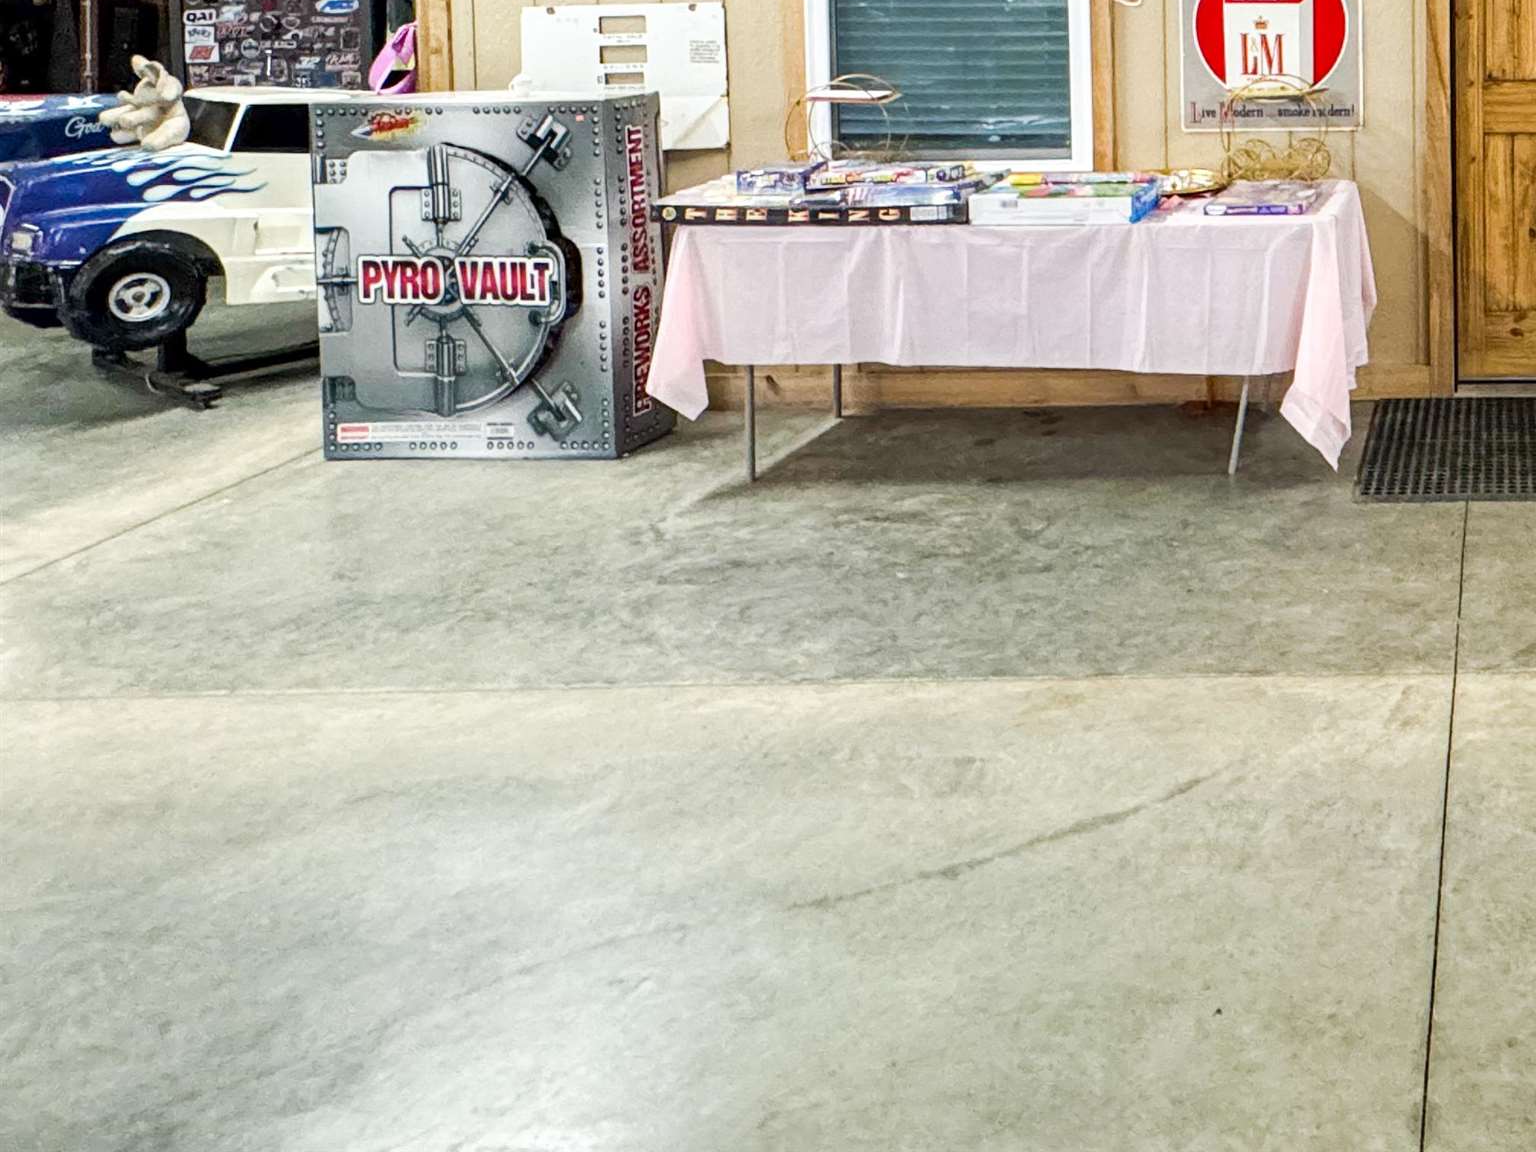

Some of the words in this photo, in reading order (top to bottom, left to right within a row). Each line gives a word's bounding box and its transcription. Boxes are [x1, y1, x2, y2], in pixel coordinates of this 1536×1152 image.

[1190, 101, 1217, 124] Live
[1277, 102, 1311, 118] smoke
[625, 124, 651, 275] ASSORTMENT
[360, 258, 443, 302] PYRO
[454, 259, 551, 303] VAULT
[632, 285, 653, 416] FIREWORKS
